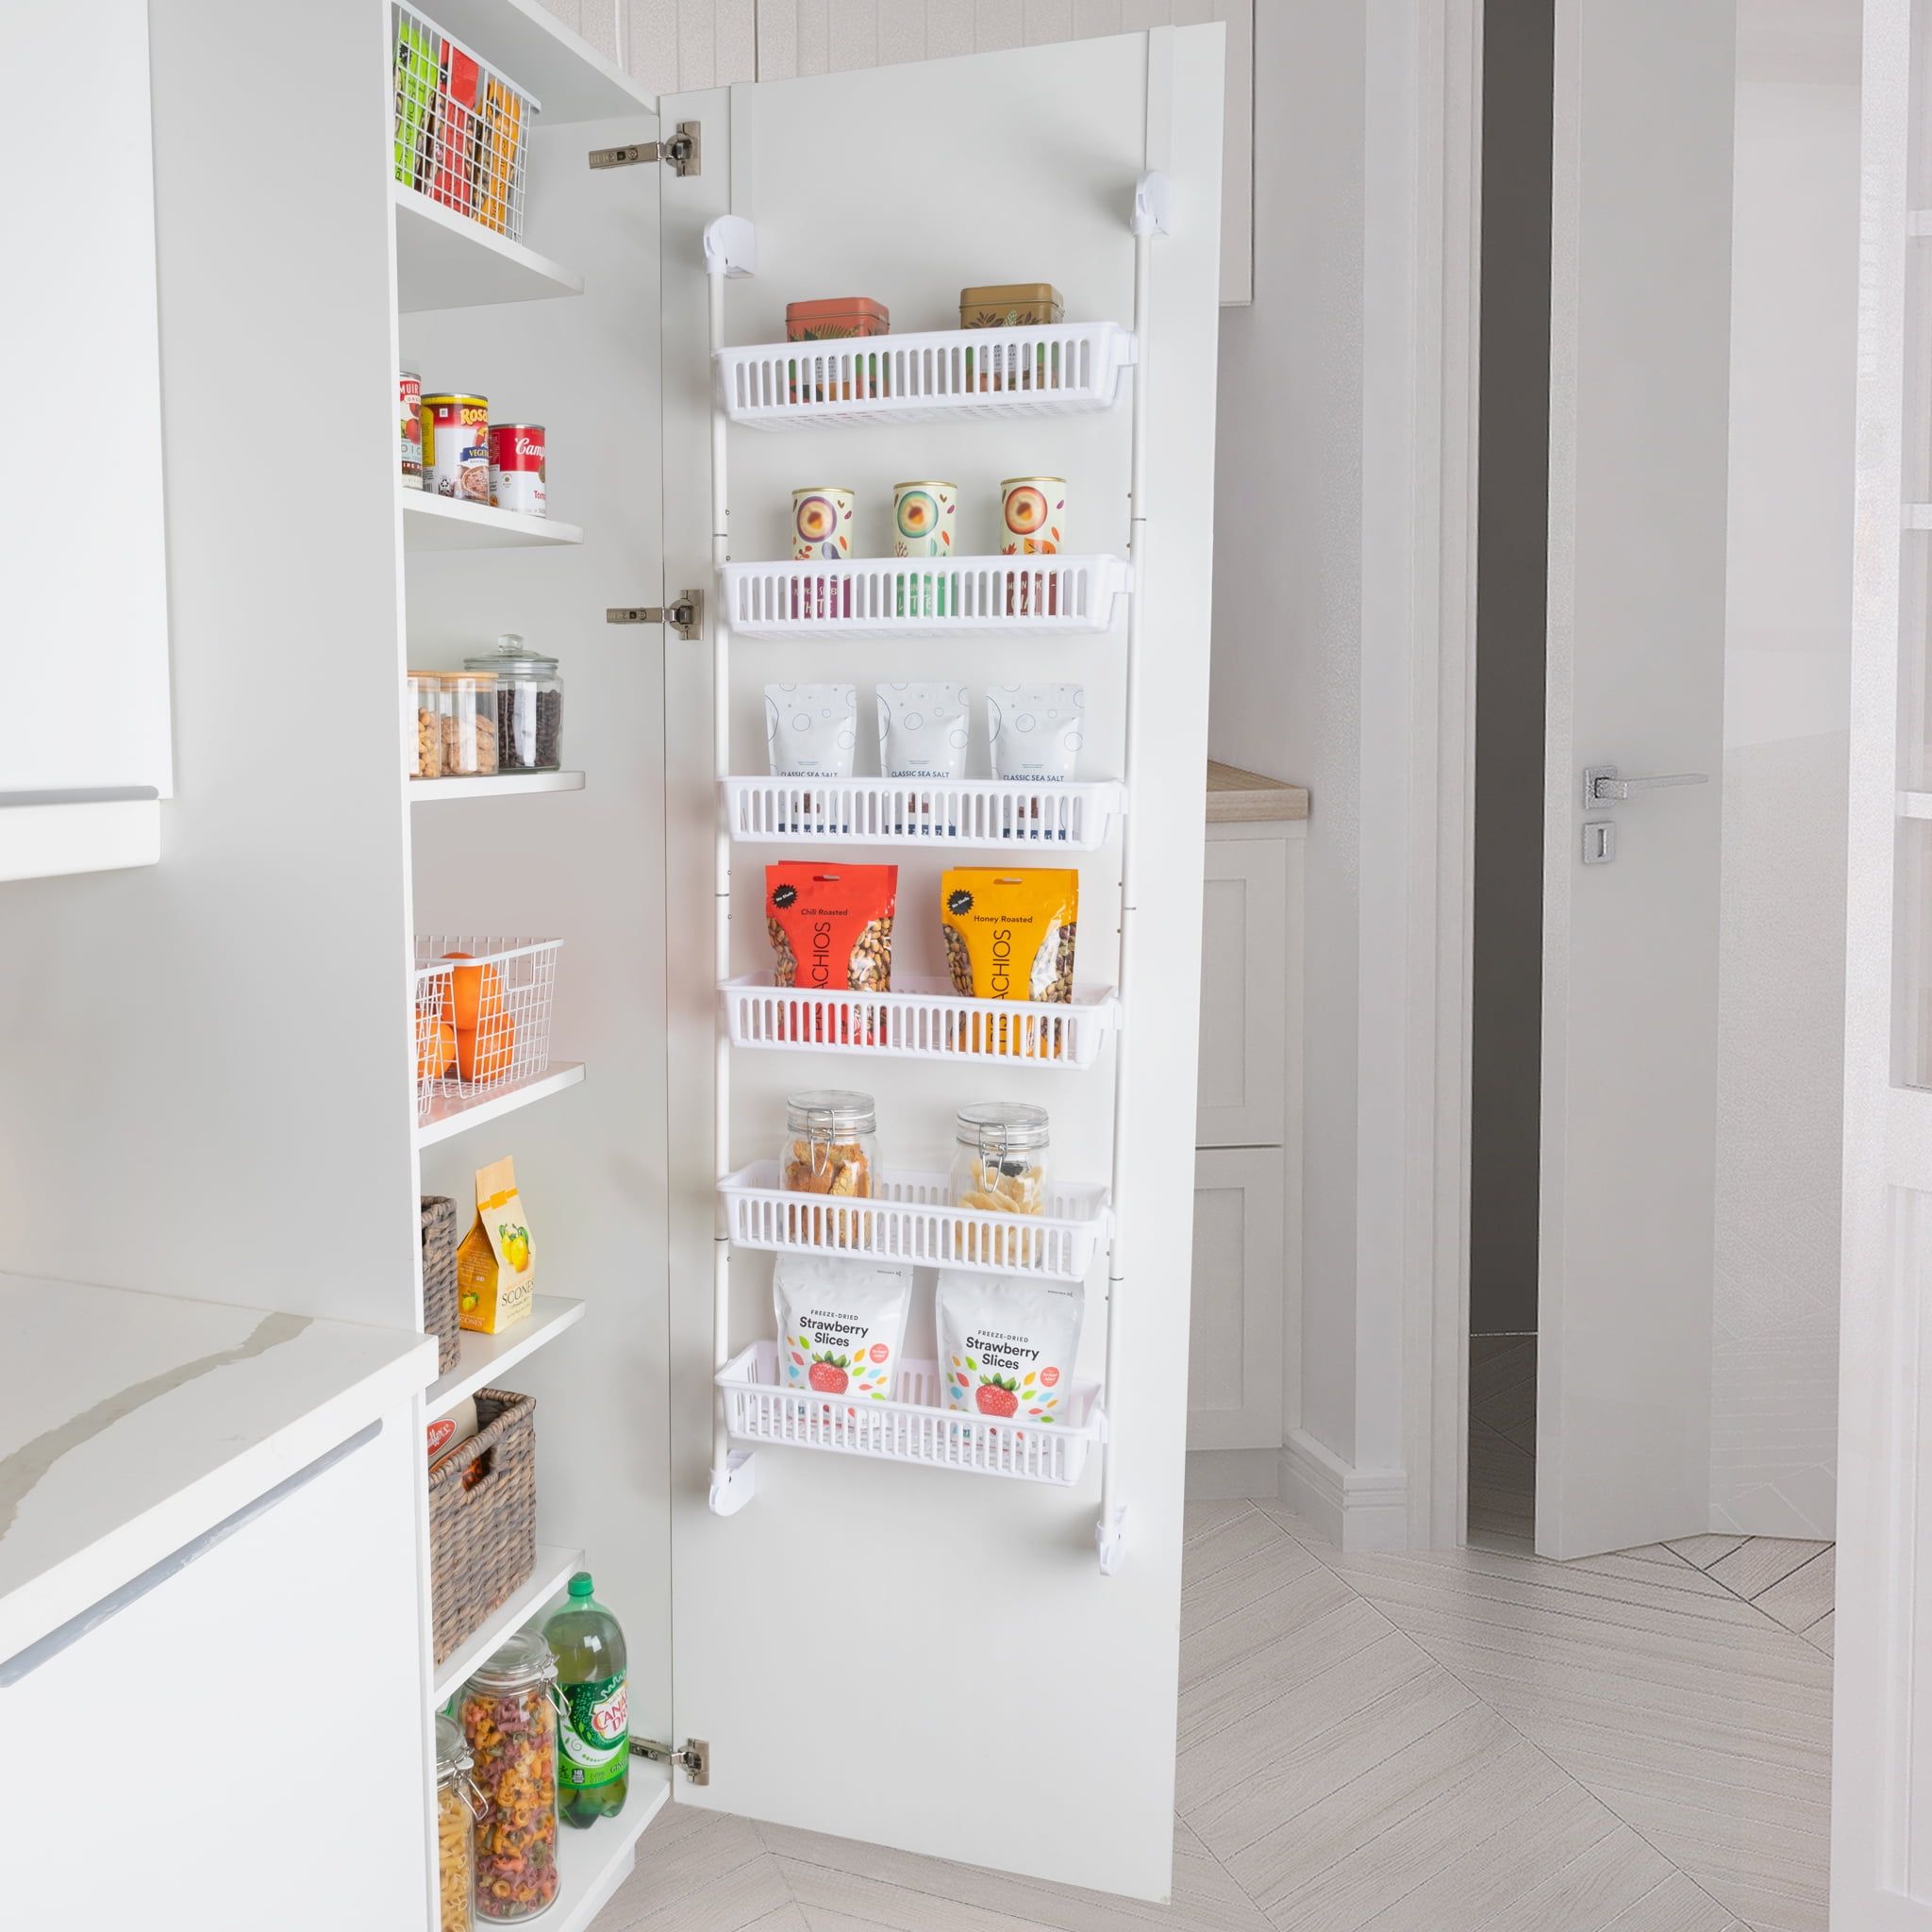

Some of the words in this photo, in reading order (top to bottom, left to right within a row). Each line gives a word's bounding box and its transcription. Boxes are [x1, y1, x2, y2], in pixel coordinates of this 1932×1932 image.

[974, 915, 999, 924] Honey
[1001, 915, 1033, 924] Roasted
[810, 1309, 858, 1321] FREEZE-DRIED
[799, 1316, 869, 1339] Strawberry
[814, 1332, 850, 1347] Slices
[977, 1329, 1029, 1343] FREEZE-DRIED
[966, 1336, 1040, 1361] Strawberry
[981, 1353, 1020, 1370] Slices
